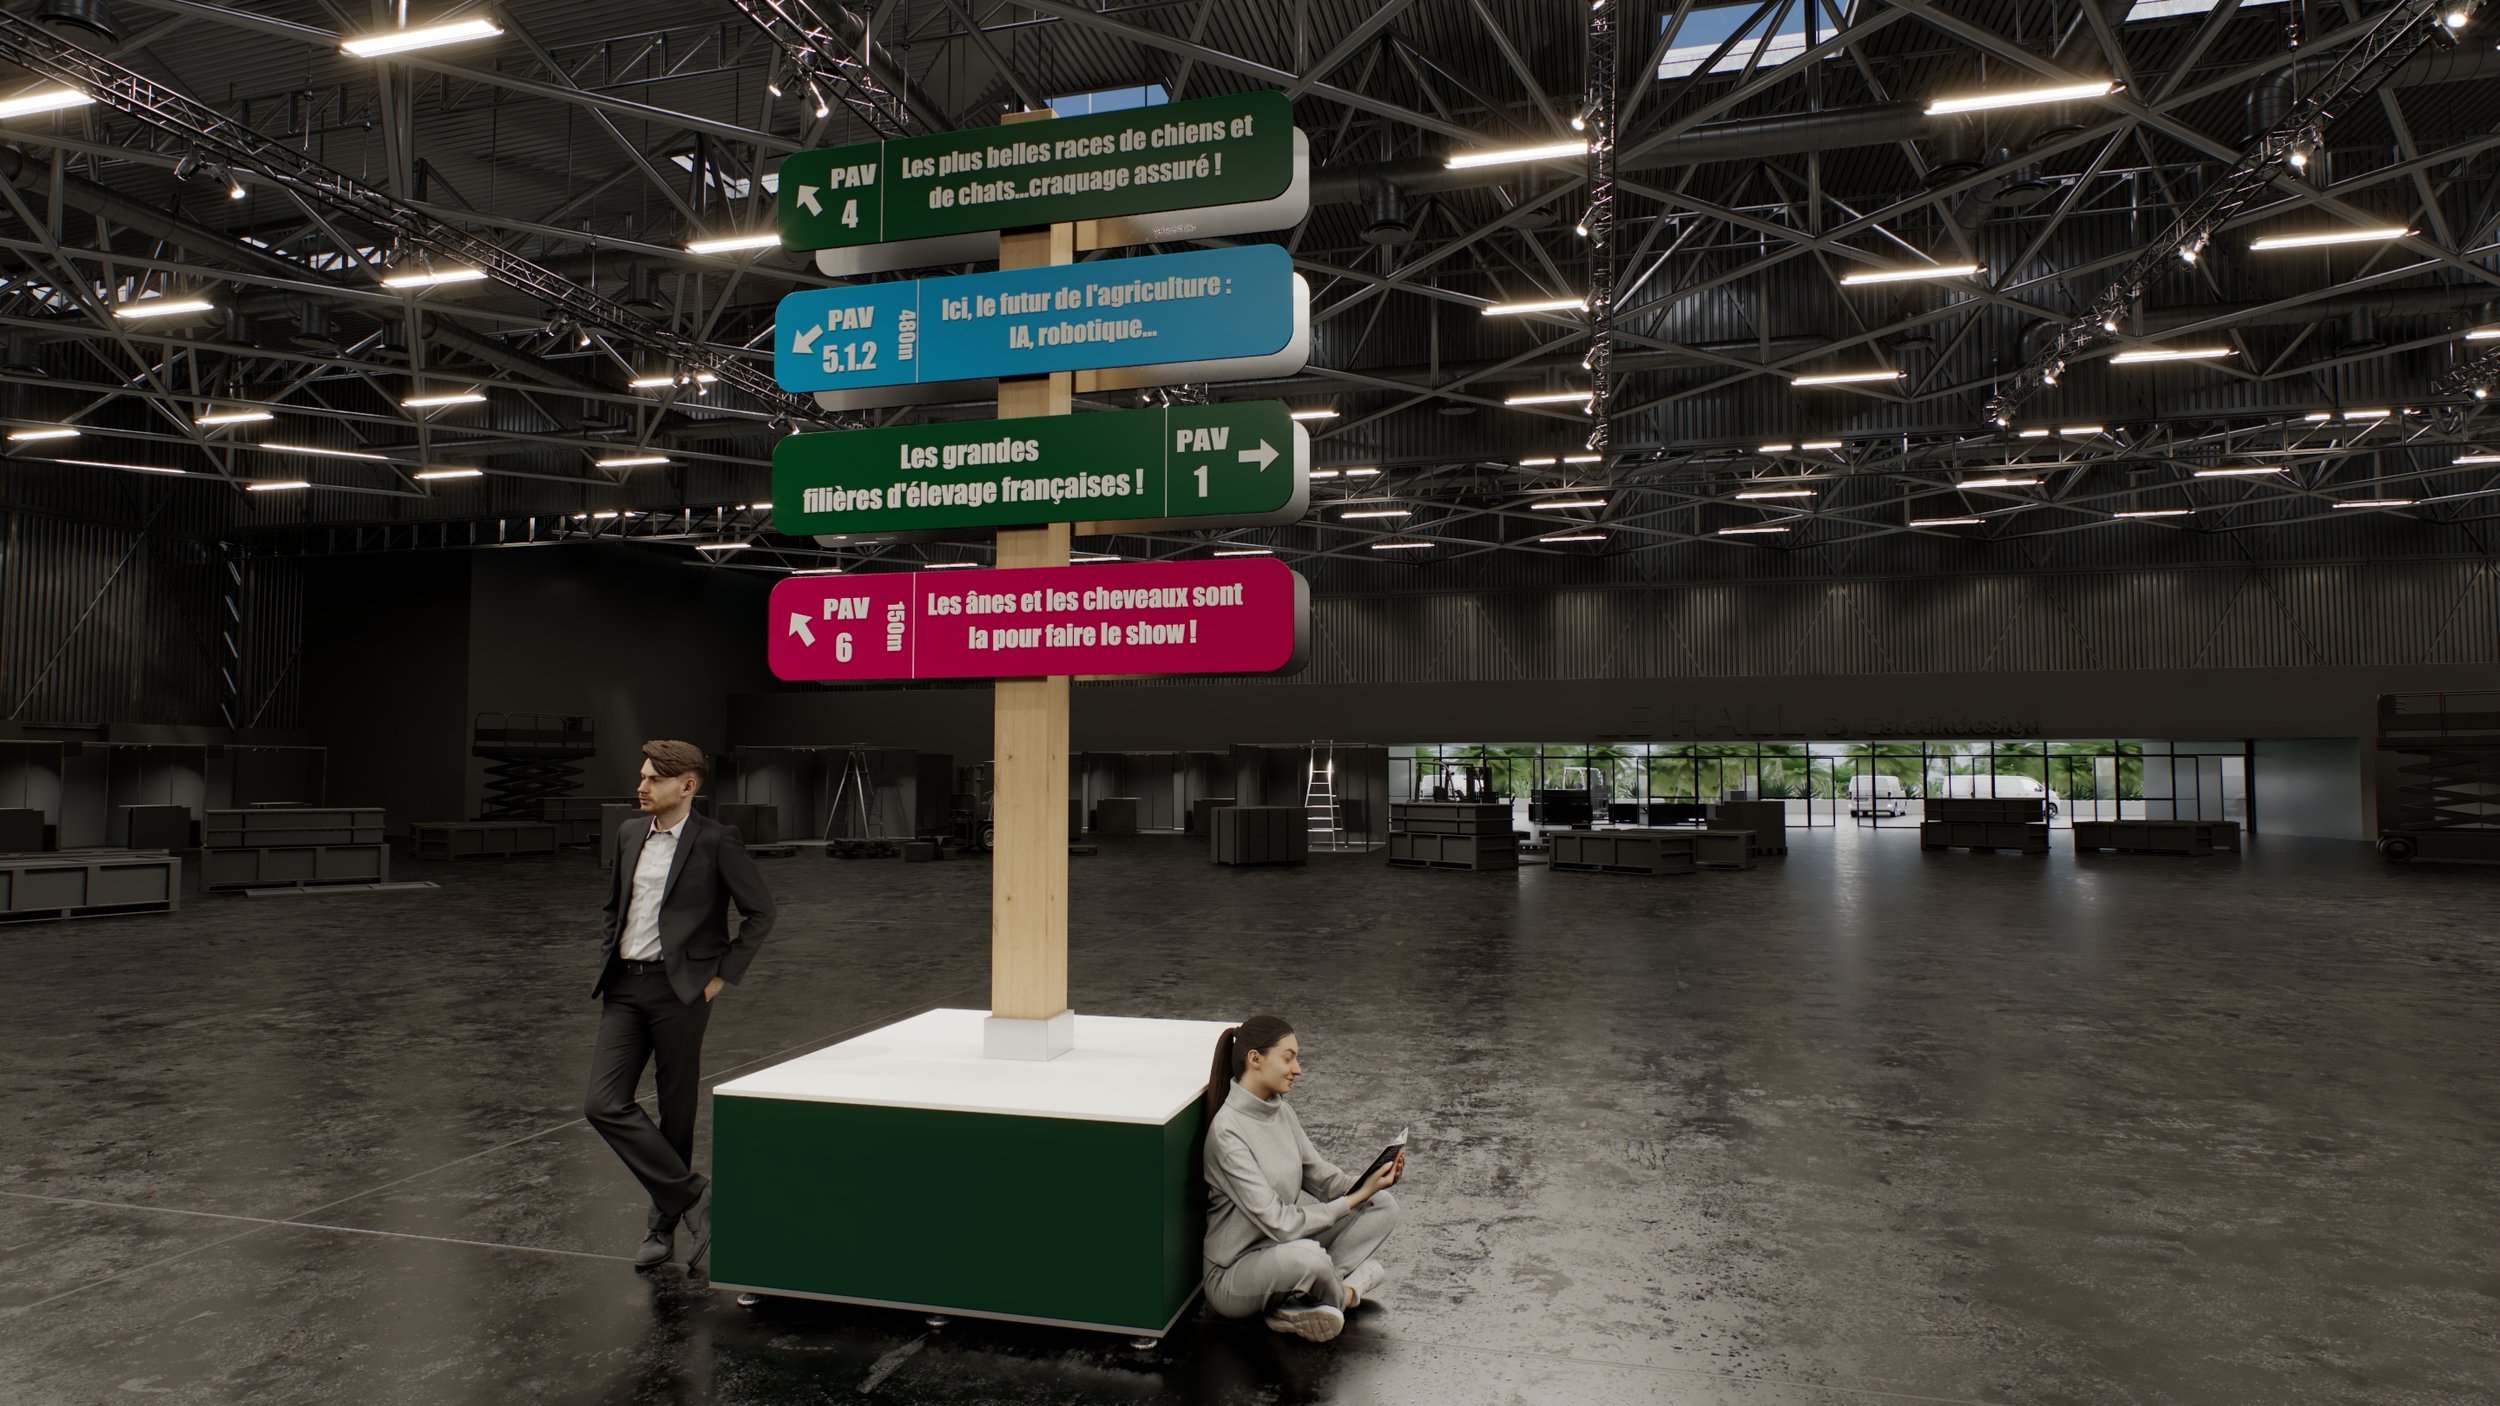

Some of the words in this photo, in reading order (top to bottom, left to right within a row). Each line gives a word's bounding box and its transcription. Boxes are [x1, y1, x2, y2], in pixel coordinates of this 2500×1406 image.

[902, 157, 935, 179] Les
[940, 151, 983, 177] plus
[987, 142, 1051, 169] belles
[1055, 135, 1115, 160] races
[1119, 129, 1147, 152] de
[1151, 121, 1226, 148] chiens
[1230, 115, 1253, 137] et
[831, 164, 877, 190] PAV
[929, 186, 954, 209] de
[1134, 153, 1210, 185] assuré
[841, 200, 859, 229] 4
[942, 296, 973, 321] Ici,
[976, 295, 996, 317] le
[999, 291, 1051, 316] futur
[1055, 286, 1082, 311] de
[1086, 275, 1221, 308] l'agriculture
[828, 305, 875, 331] PAV
[1009, 325, 1035, 350] IA,
[1038, 318, 1158, 348] robotique...
[898, 309, 916, 361] 480m
[822, 341, 877, 373] 5.1.2
[900, 443, 938, 470] Les
[942, 436, 1039, 470] grandes
[1176, 426, 1230, 453] PAV
[802, 484, 882, 514] filières
[886, 480, 998, 509] d'élevage
[1001, 471, 1131, 506] françaises
[1193, 465, 1208, 498] 1
[823, 596, 871, 621] PAV
[927, 592, 962, 616] Les
[965, 588, 1017, 615] ânes
[1020, 590, 1043, 613] et
[1046, 587, 1079, 612] les
[1083, 585, 1189, 611] cheveaux
[1192, 582, 1244, 607] sont
[886, 601, 905, 652] 150m
[968, 625, 989, 650] la
[992, 626, 1042, 651] pour
[1045, 622, 1097, 648] faire
[1100, 621, 1122, 647] le
[1125, 621, 1186, 646] show
[835, 632, 853, 663] 6
[1671, 702, 1806, 736] HALL
